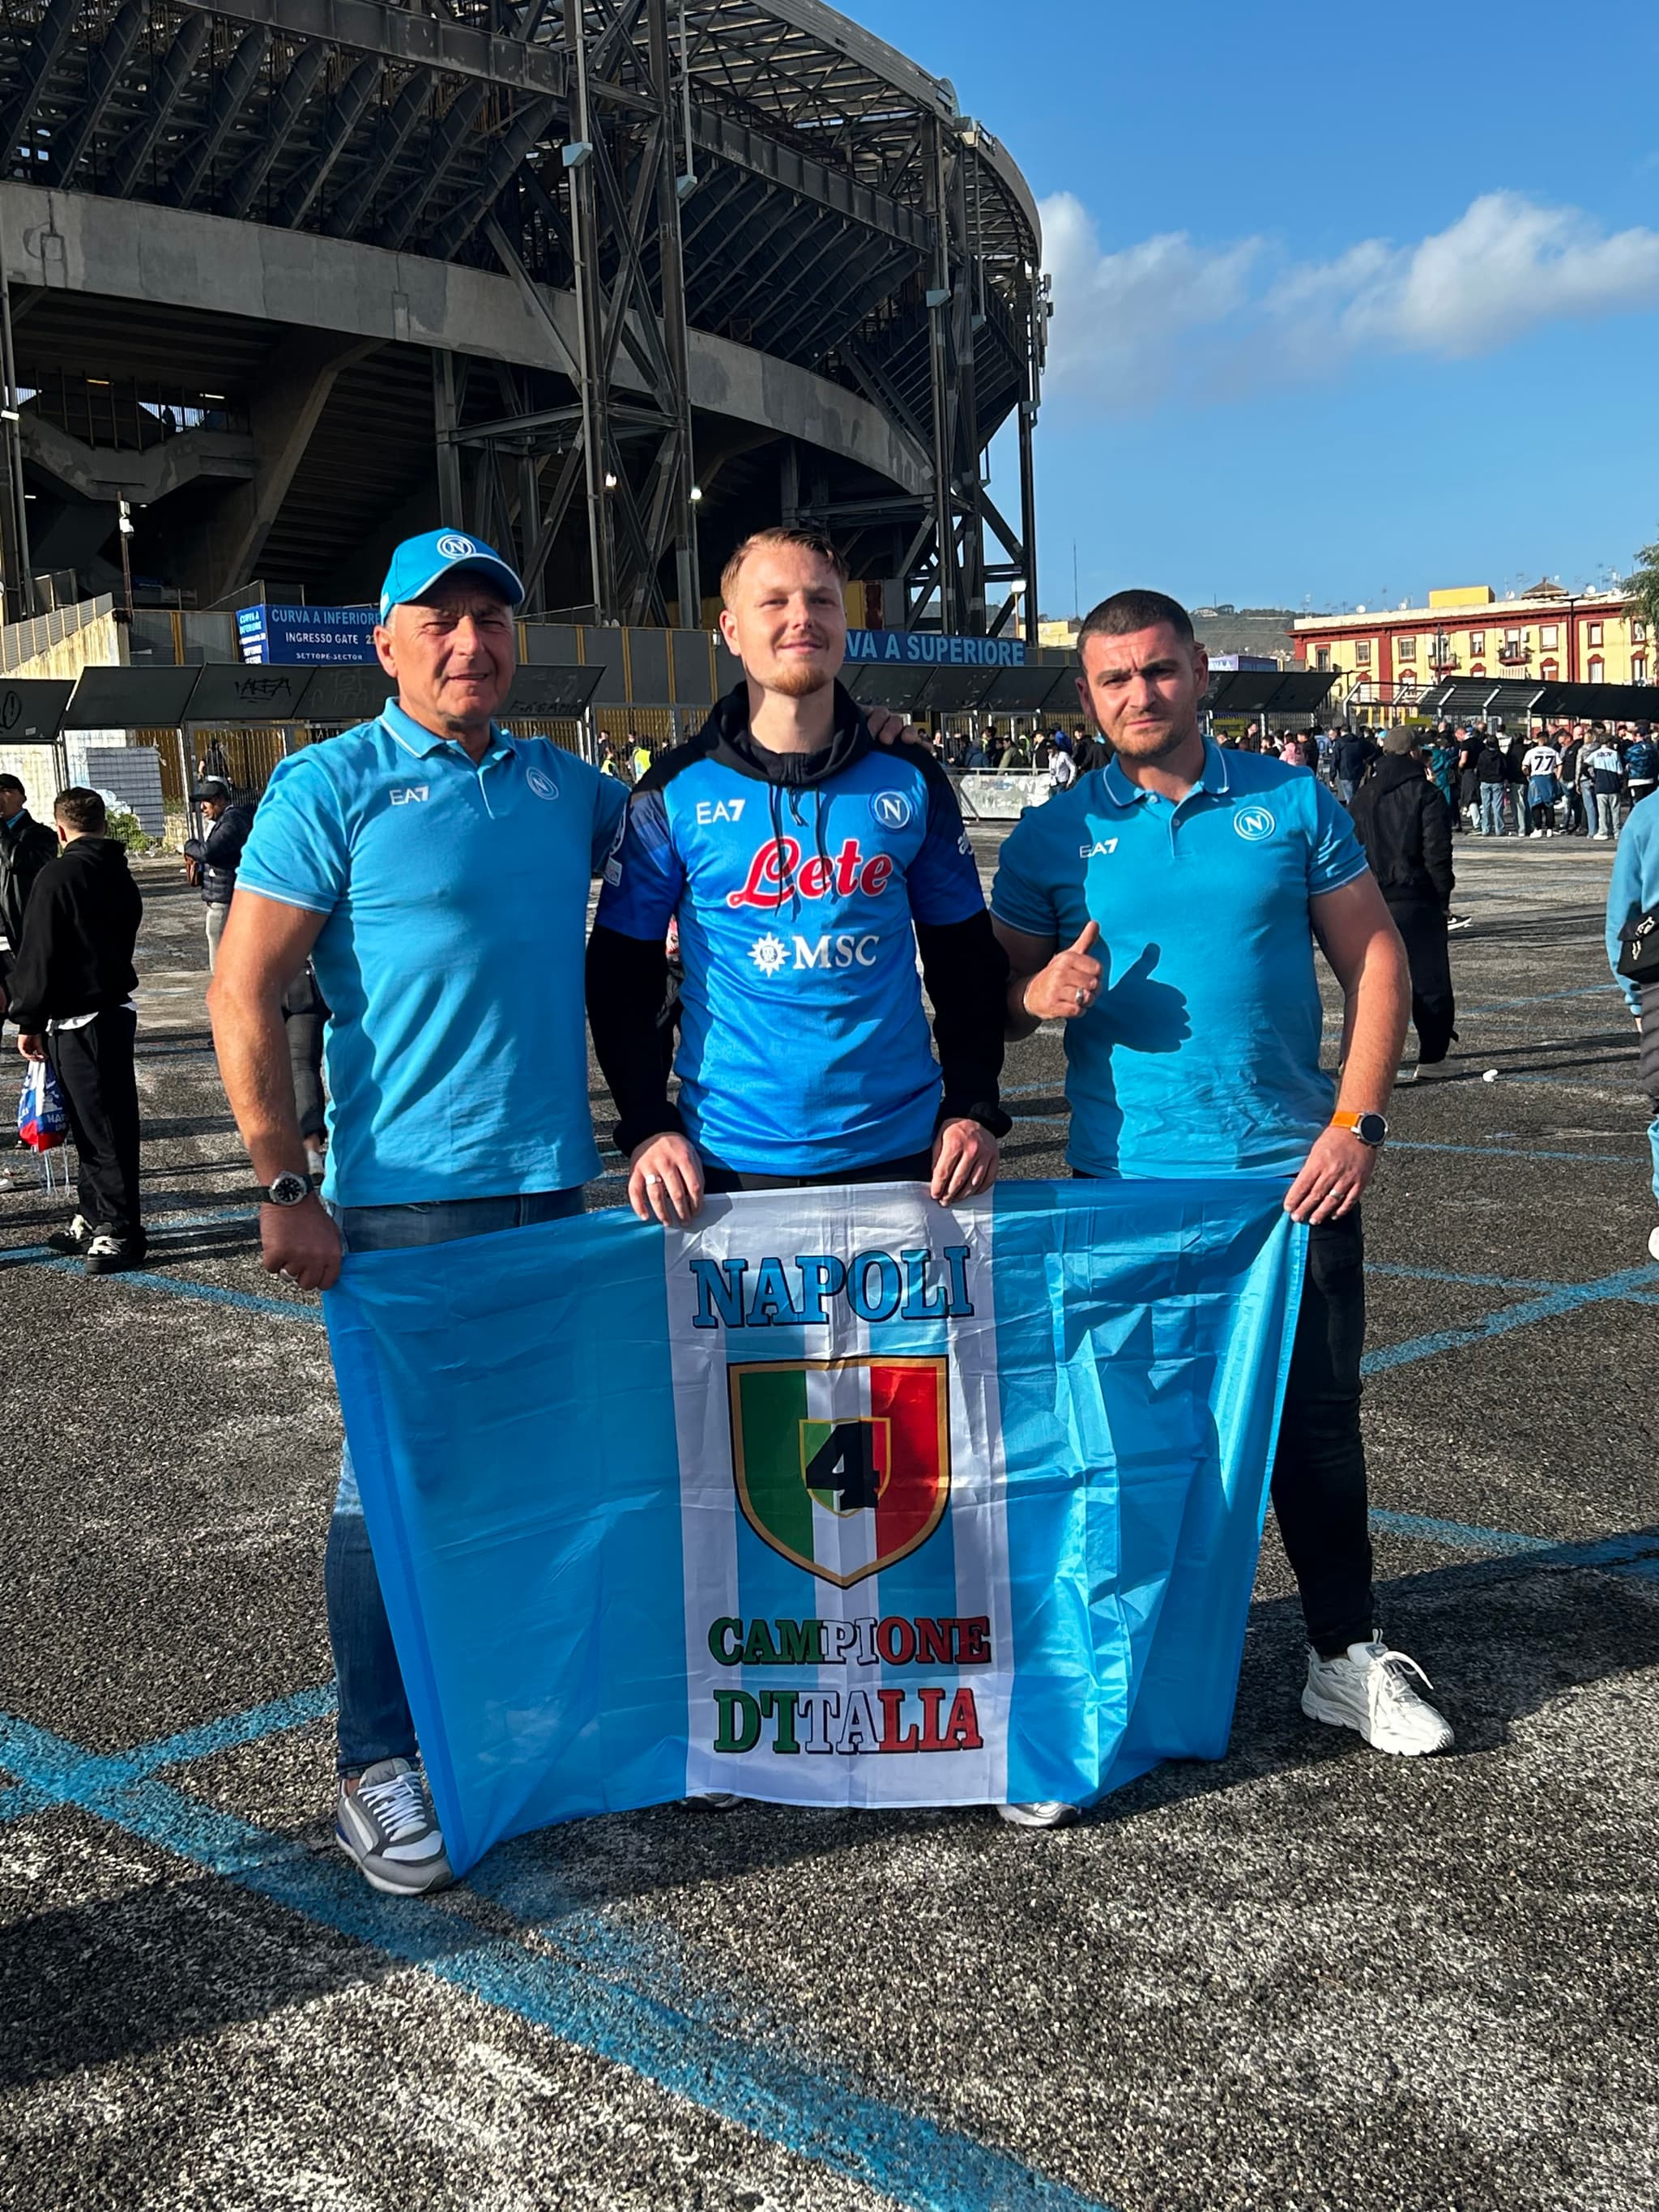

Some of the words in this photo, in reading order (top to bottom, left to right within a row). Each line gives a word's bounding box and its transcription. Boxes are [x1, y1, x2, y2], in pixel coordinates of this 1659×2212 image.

[271, 609, 309, 623] CURVA
[313, 611, 321, 624] A
[324, 611, 382, 625] INFERIORE
[285, 632, 333, 644] INGRESSO
[335, 633, 359, 645] GATE
[845, 631, 878, 658] VA
[885, 633, 901, 659] A
[906, 635, 1025, 667] SUPERIORE
[1534, 755, 1555, 772] 77
[389, 785, 429, 806] EA7
[696, 798, 746, 825] EA7
[881, 798, 902, 822] N
[1244, 815, 1263, 833] N
[1079, 837, 1119, 859] EA7
[727, 836, 893, 909] Lete
[791, 935, 881, 970] MSC
[689, 1245, 975, 1329] NAPOLI
[805, 1420, 881, 1511] 4
[708, 1616, 992, 1667] CAMPIONE
[713, 1687, 984, 1754] D'ITALIA
